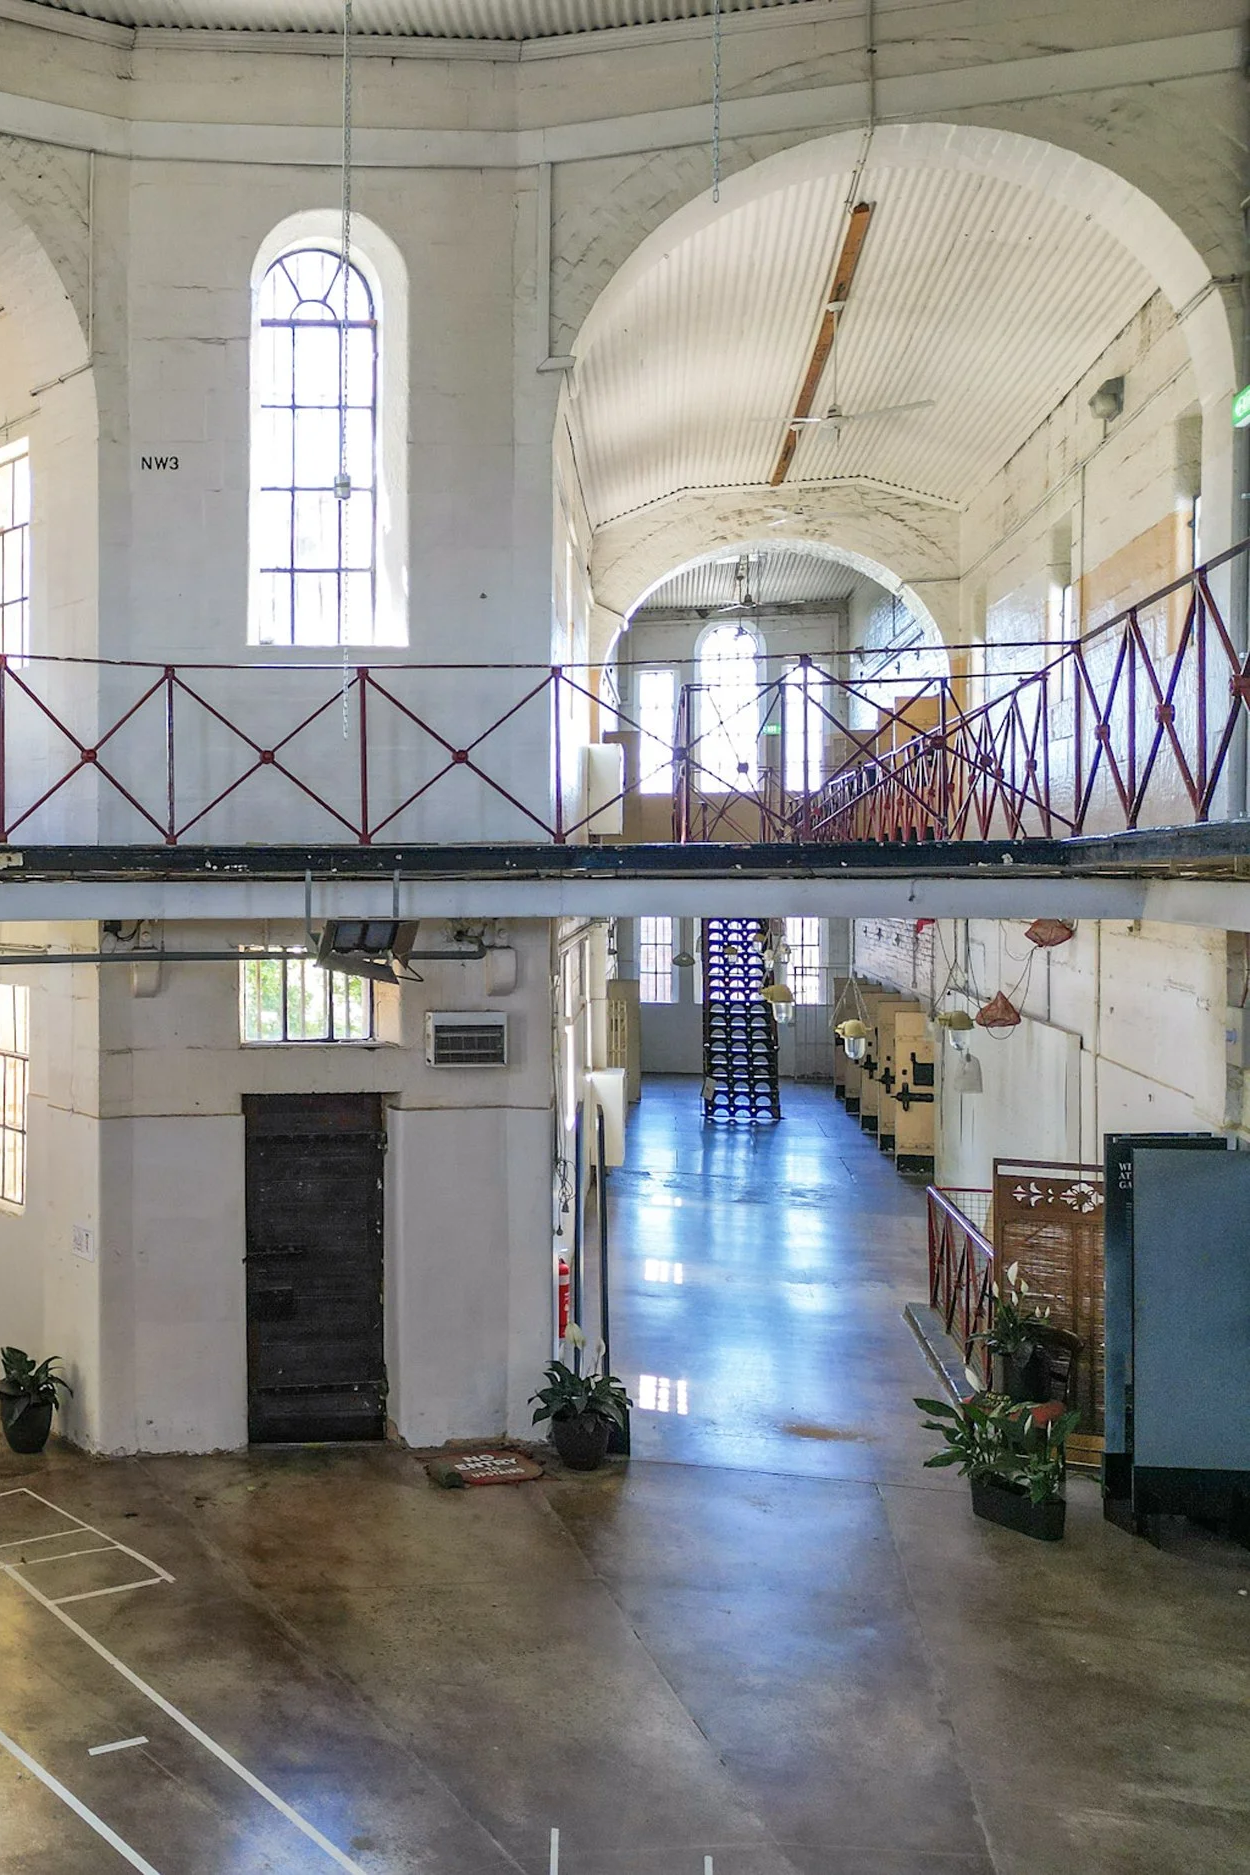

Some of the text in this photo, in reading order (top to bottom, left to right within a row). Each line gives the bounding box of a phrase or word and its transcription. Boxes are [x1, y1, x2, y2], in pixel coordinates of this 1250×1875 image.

[141, 455, 179, 471] NW3
[454, 1457, 518, 1471] ENTRY
[461, 1454, 495, 1463] NO
[470, 1467, 525, 1478] UPSTAIRS
